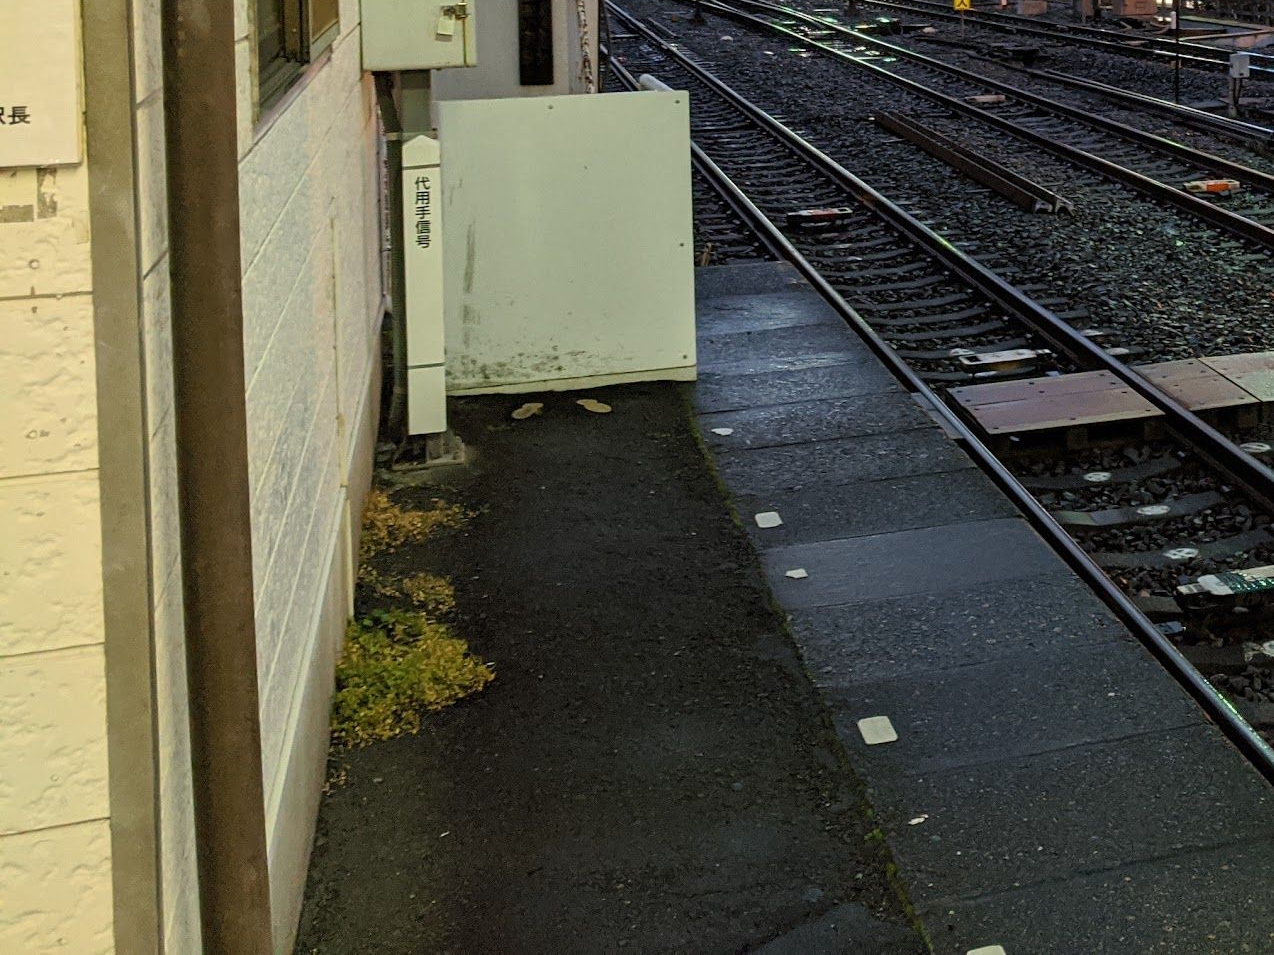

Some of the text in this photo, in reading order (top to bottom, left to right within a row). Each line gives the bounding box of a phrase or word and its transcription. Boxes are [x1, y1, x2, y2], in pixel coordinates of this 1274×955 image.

[414, 175, 432, 249] 代用手信号
